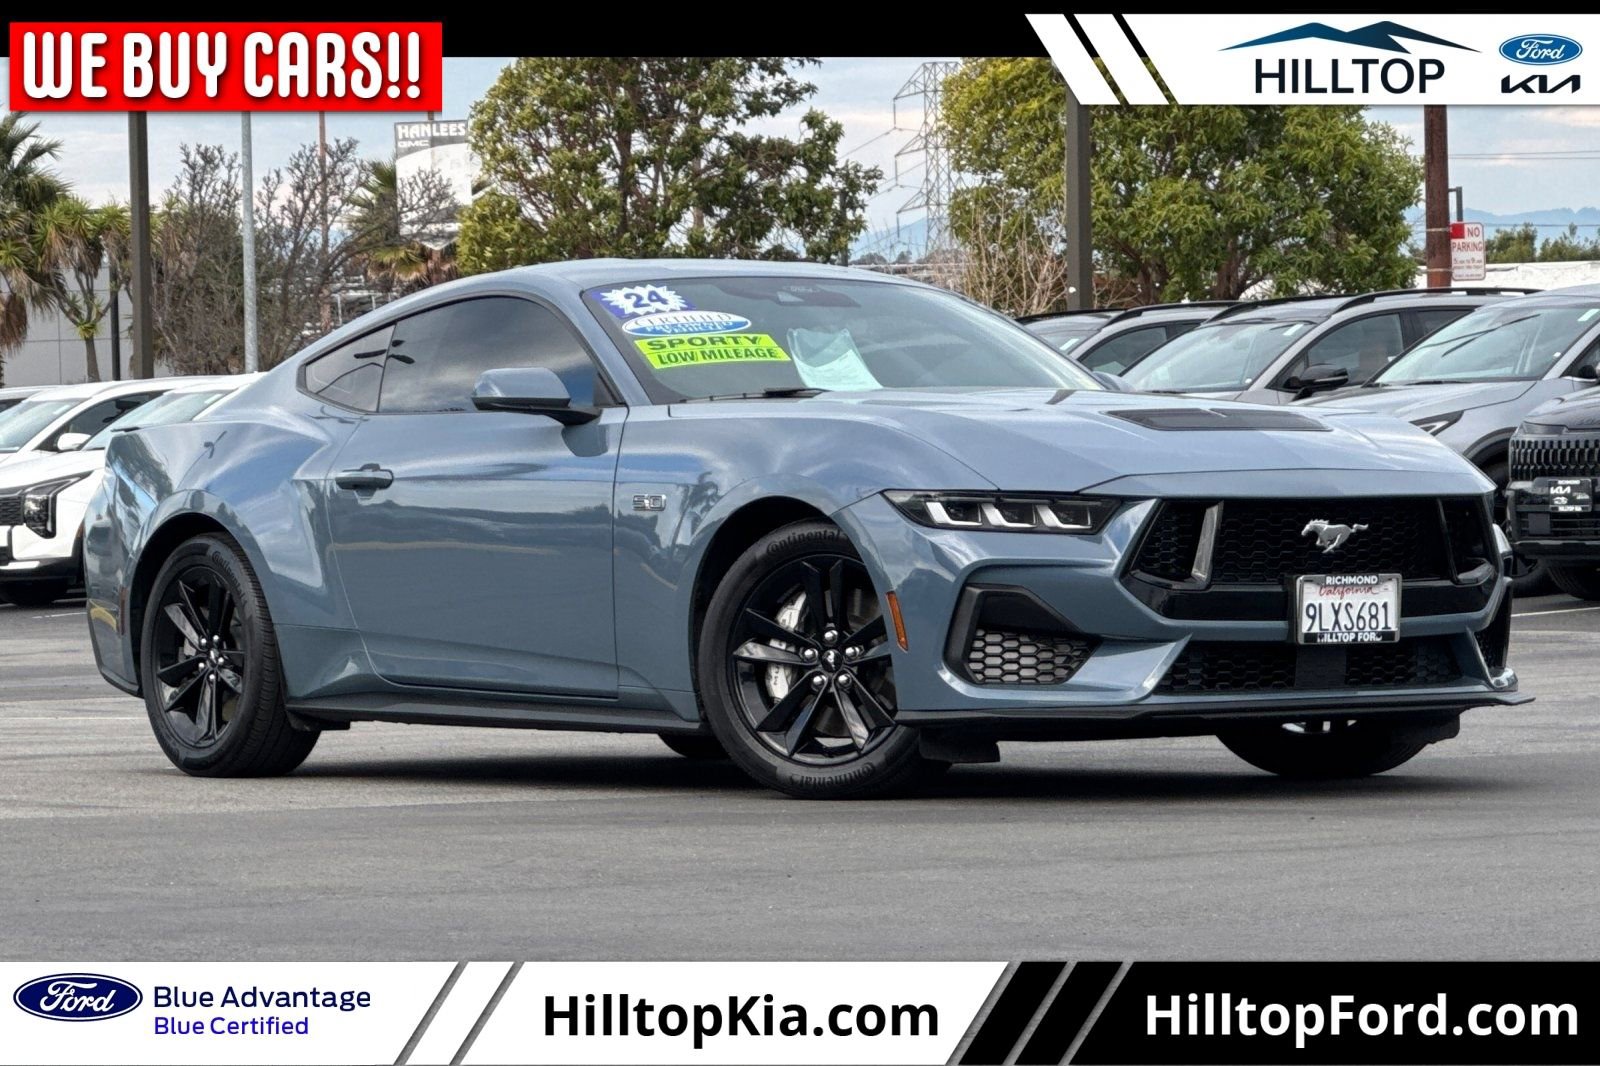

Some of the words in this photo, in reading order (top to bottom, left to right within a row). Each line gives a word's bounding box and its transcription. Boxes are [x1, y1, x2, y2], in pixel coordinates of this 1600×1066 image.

[397, 123, 466, 139] HANLEES
[1467, 227, 1480, 237] NO
[1452, 242, 1483, 252] PARKING
[624, 290, 669, 308] 24
[646, 334, 763, 351] SPORTY
[657, 350, 698, 365] LOW
[701, 348, 780, 361] MILEAGE
[766, 529, 841, 555] Continental
[1325, 575, 1379, 586] RICHMOND
[1318, 585, 1380, 600] California
[1305, 601, 1392, 632] 9LXS681
